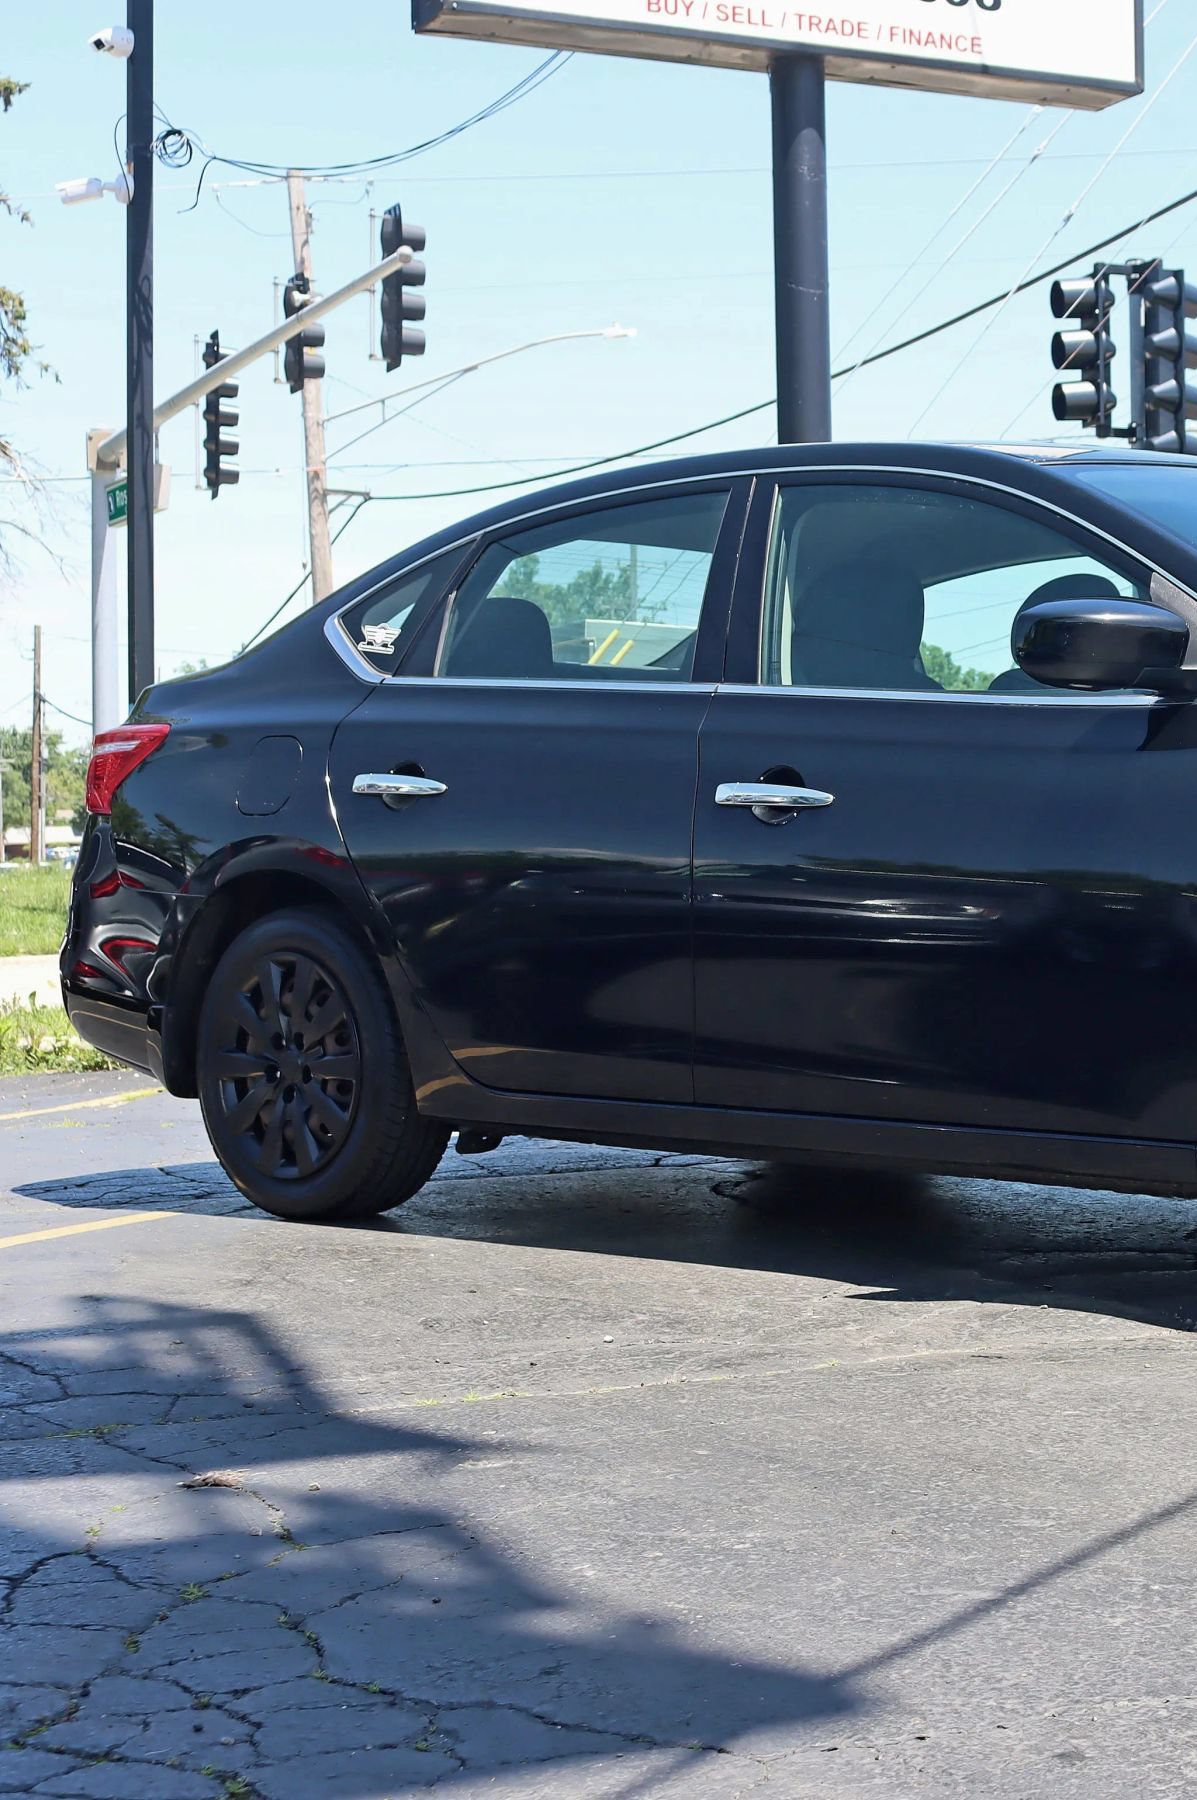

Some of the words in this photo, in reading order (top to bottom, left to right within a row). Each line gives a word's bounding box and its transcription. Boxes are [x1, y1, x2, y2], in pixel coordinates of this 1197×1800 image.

[647, 0, 694, 17] BUY
[716, 4, 774, 27] SELL
[793, 13, 871, 39] TRADE
[889, 26, 984, 54] FINANCE
